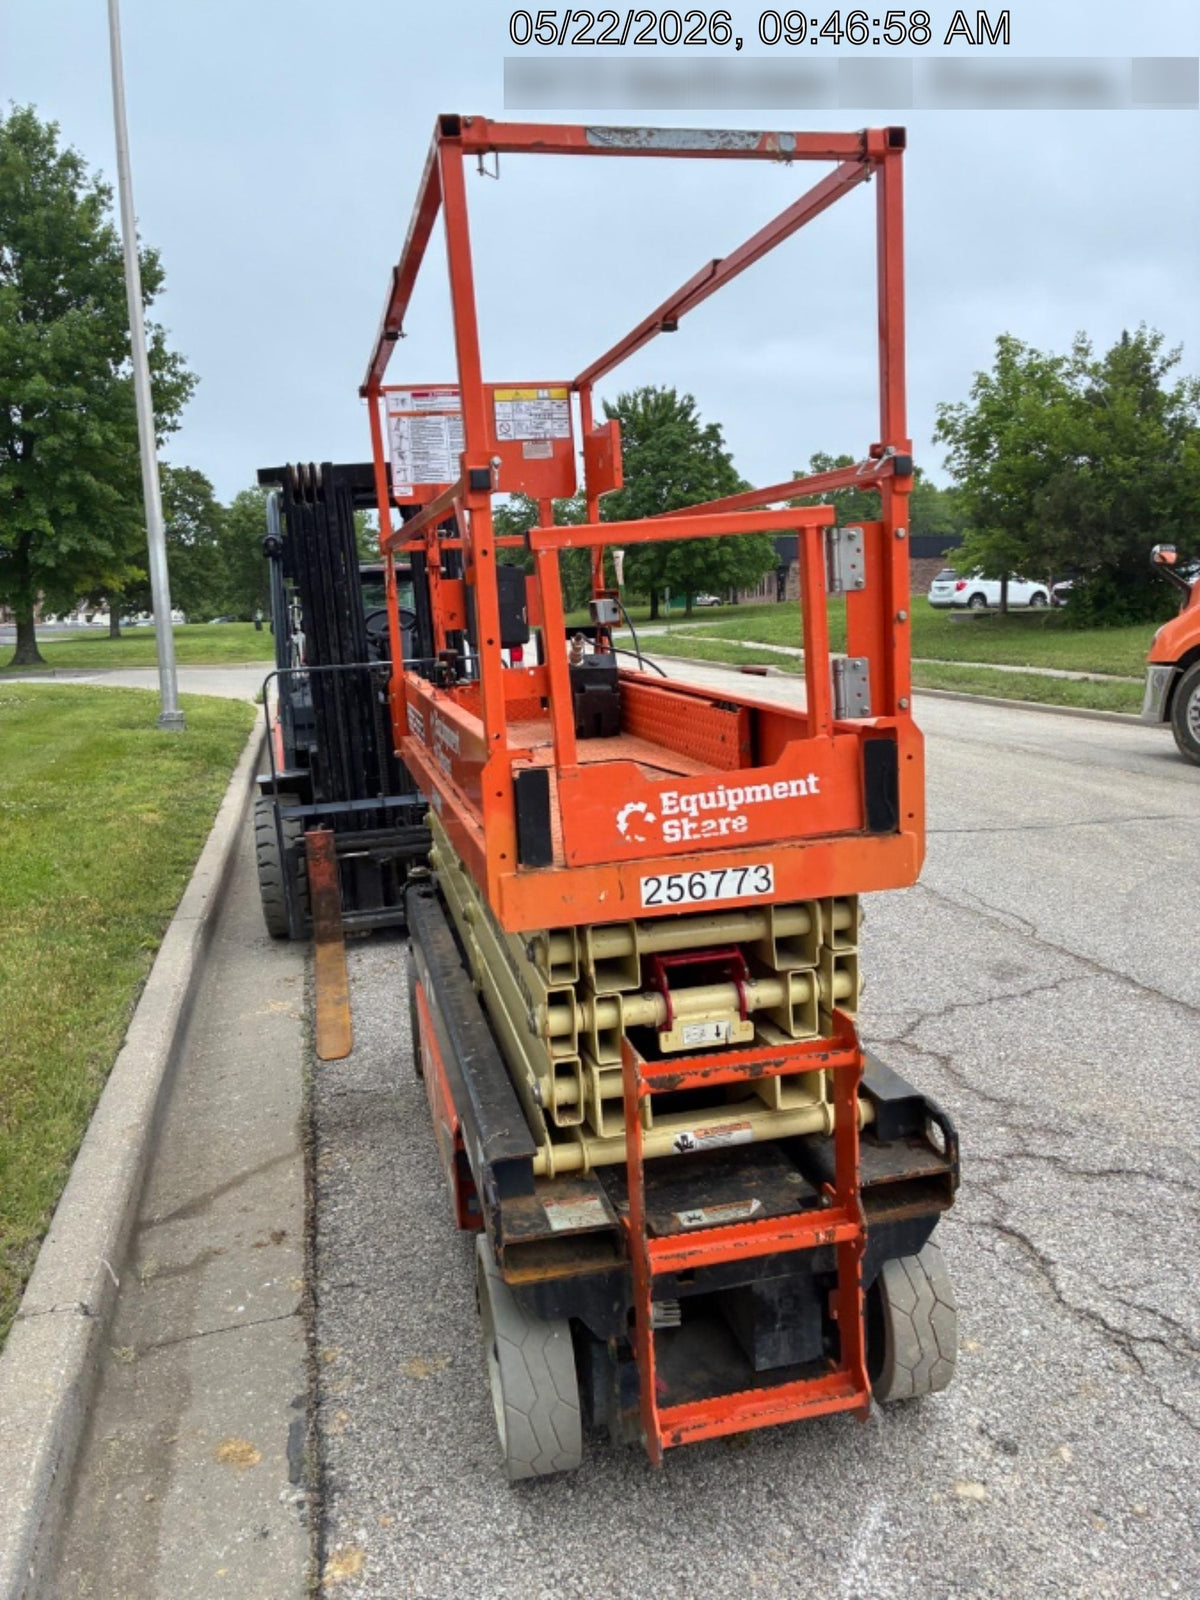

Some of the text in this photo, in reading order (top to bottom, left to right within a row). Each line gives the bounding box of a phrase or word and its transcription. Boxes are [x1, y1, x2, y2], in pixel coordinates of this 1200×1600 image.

[660, 772, 820, 817] Equipment
[662, 815, 748, 843] Share
[643, 864, 772, 905] 256773
